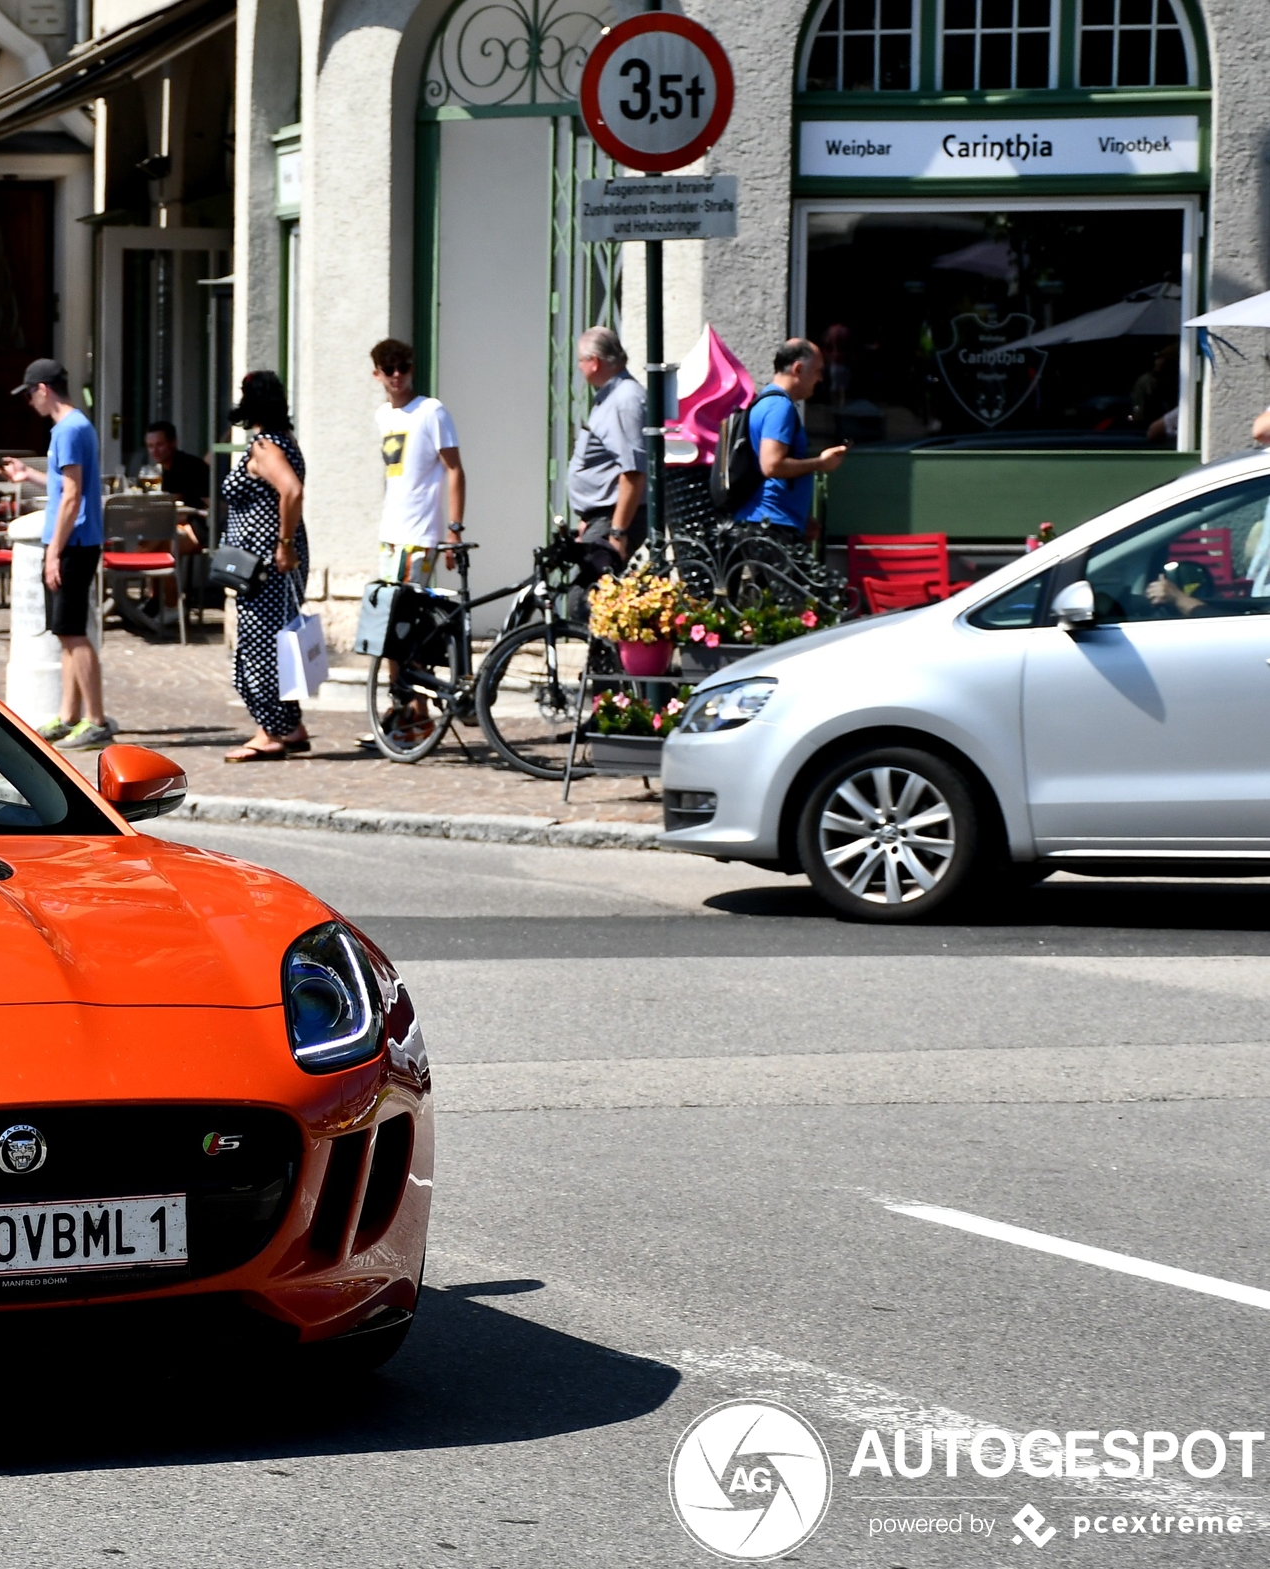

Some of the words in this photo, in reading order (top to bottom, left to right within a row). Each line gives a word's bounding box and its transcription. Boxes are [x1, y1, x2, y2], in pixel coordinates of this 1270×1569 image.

[826, 139, 892, 158] Weinbar
[942, 133, 1053, 161] Carinthia
[1098, 135, 1172, 154] Vinothek
[603, 181, 673, 199] Ausgenommen
[675, 181, 715, 194] Anrainer
[583, 202, 647, 216] Zustelldienste
[613, 220, 631, 234] und
[633, 219, 701, 235] Hotelzubringer
[958, 348, 1025, 366] Carinthia
[150, 1205, 168, 1254] 1
[2, 1279, 41, 1287] MANFRED
[42, 1277, 68, 1286] BÖHM
